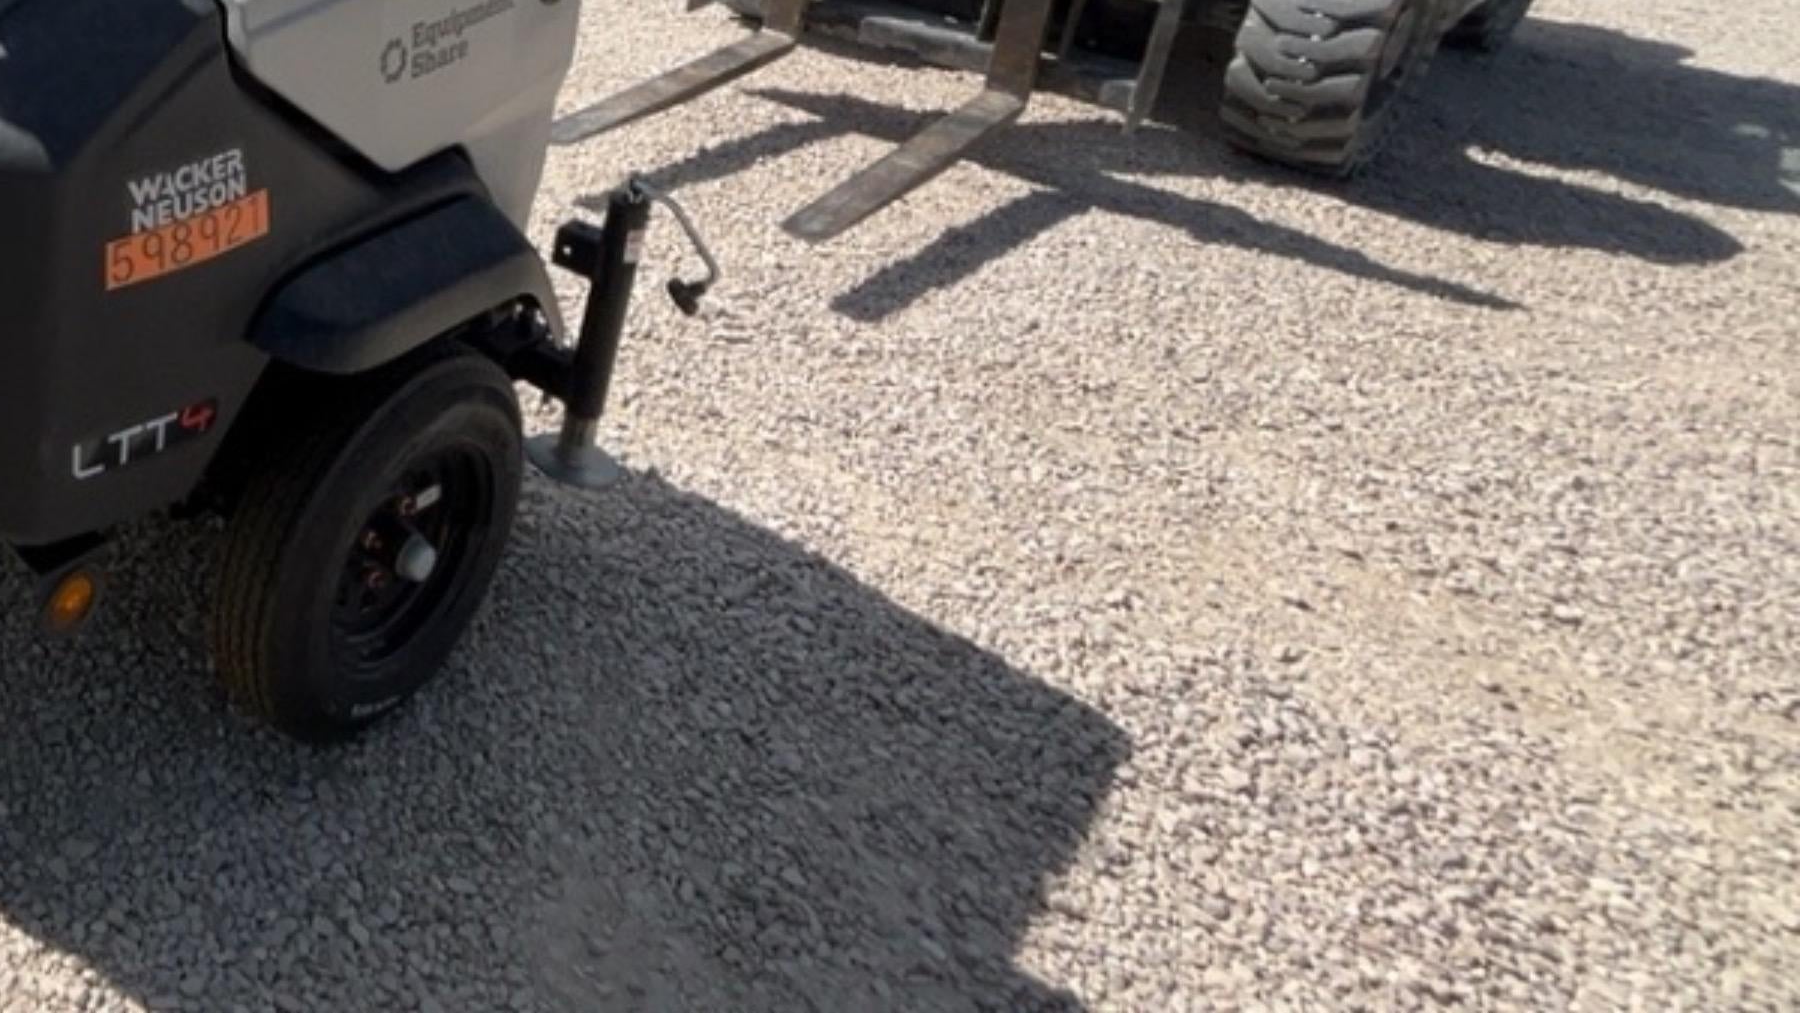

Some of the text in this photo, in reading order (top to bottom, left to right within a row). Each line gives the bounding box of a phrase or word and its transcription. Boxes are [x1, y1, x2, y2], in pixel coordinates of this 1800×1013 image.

[411, 40, 469, 79] Share
[128, 148, 243, 205] WACKER
[132, 172, 246, 234] NEUSON
[111, 194, 261, 283] 598921
